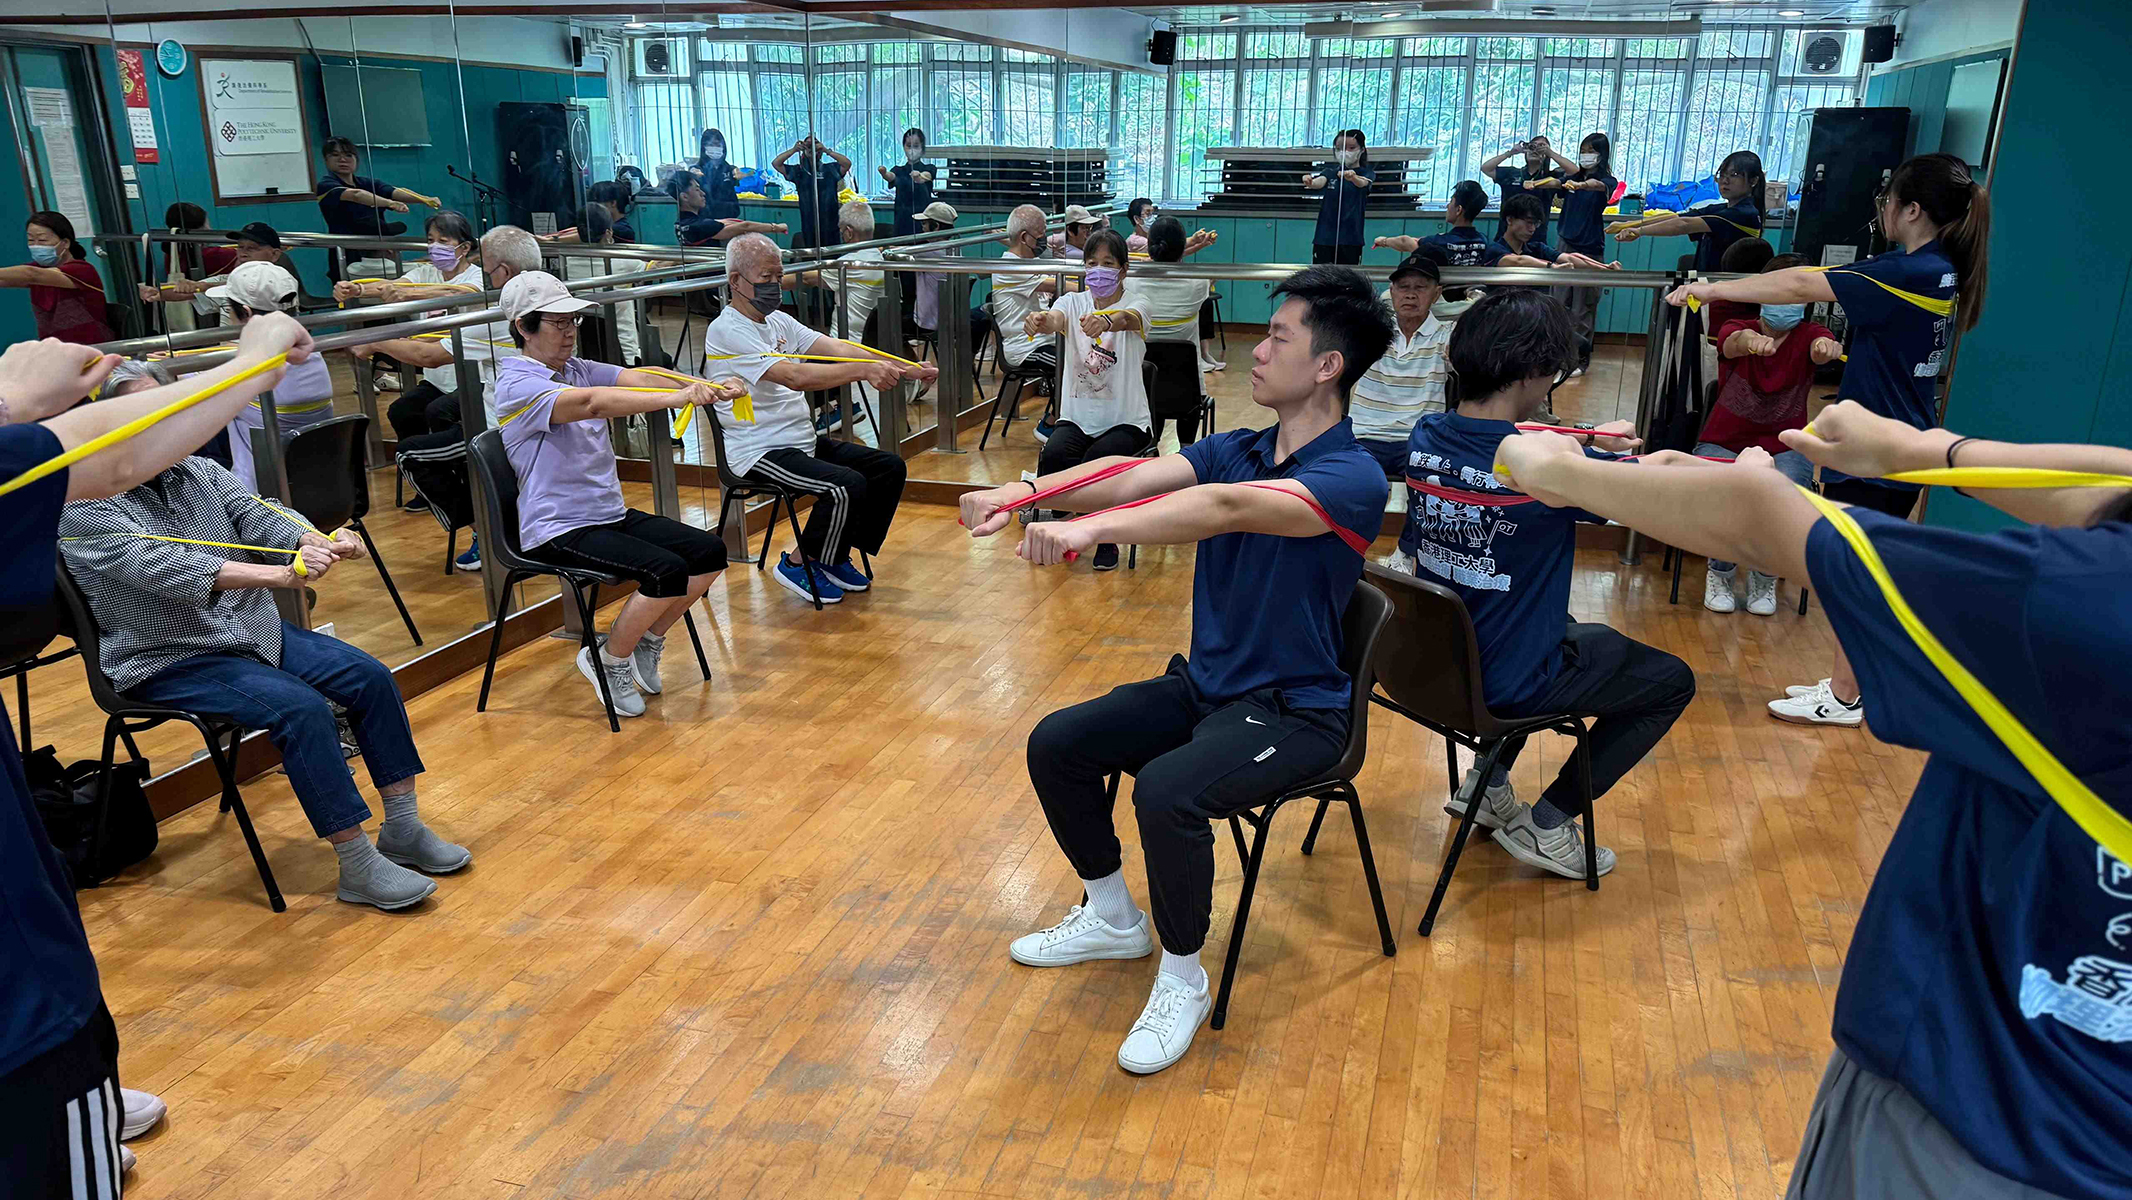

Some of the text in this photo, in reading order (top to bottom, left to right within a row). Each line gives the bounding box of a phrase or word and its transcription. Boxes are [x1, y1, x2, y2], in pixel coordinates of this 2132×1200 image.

[1499, 523, 1511, 533] OT
[1421, 538, 1496, 574] 香港理工大學
